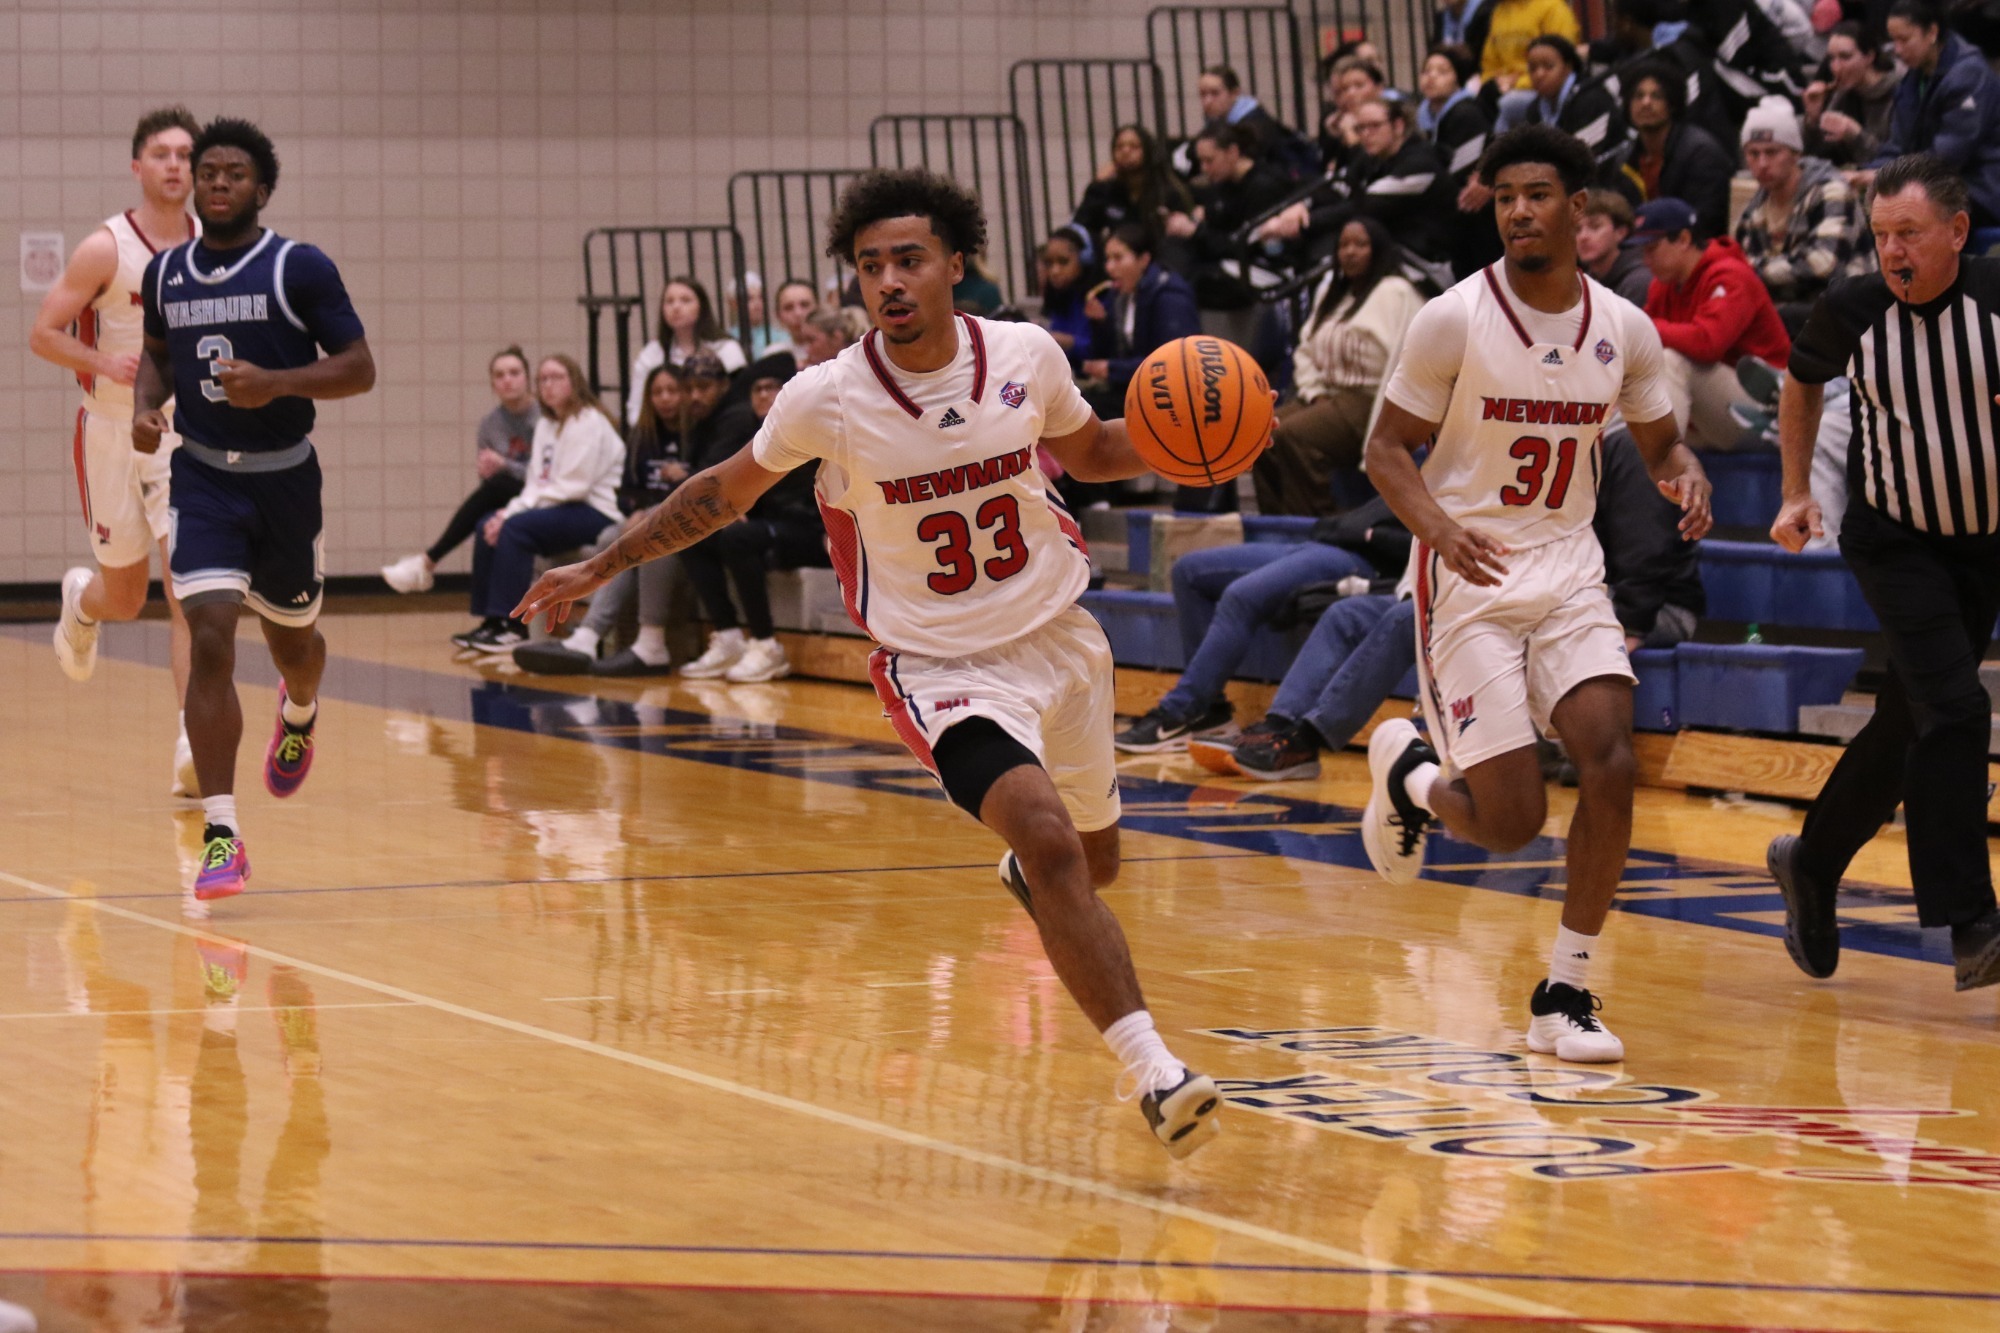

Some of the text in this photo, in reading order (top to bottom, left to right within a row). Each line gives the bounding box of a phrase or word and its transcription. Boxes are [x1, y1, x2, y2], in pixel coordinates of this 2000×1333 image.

[164, 294, 269, 329] WASHBURN
[196, 334, 234, 403] 3
[1195, 340, 1228, 429] Wilson
[938, 417, 966, 429] adidas
[1480, 396, 1610, 425] NEWMAN
[874, 444, 1032, 504] NEWMAN
[1500, 435, 1578, 510] 31
[917, 494, 1029, 595] 33
[1209, 1026, 1702, 1105] COURT
